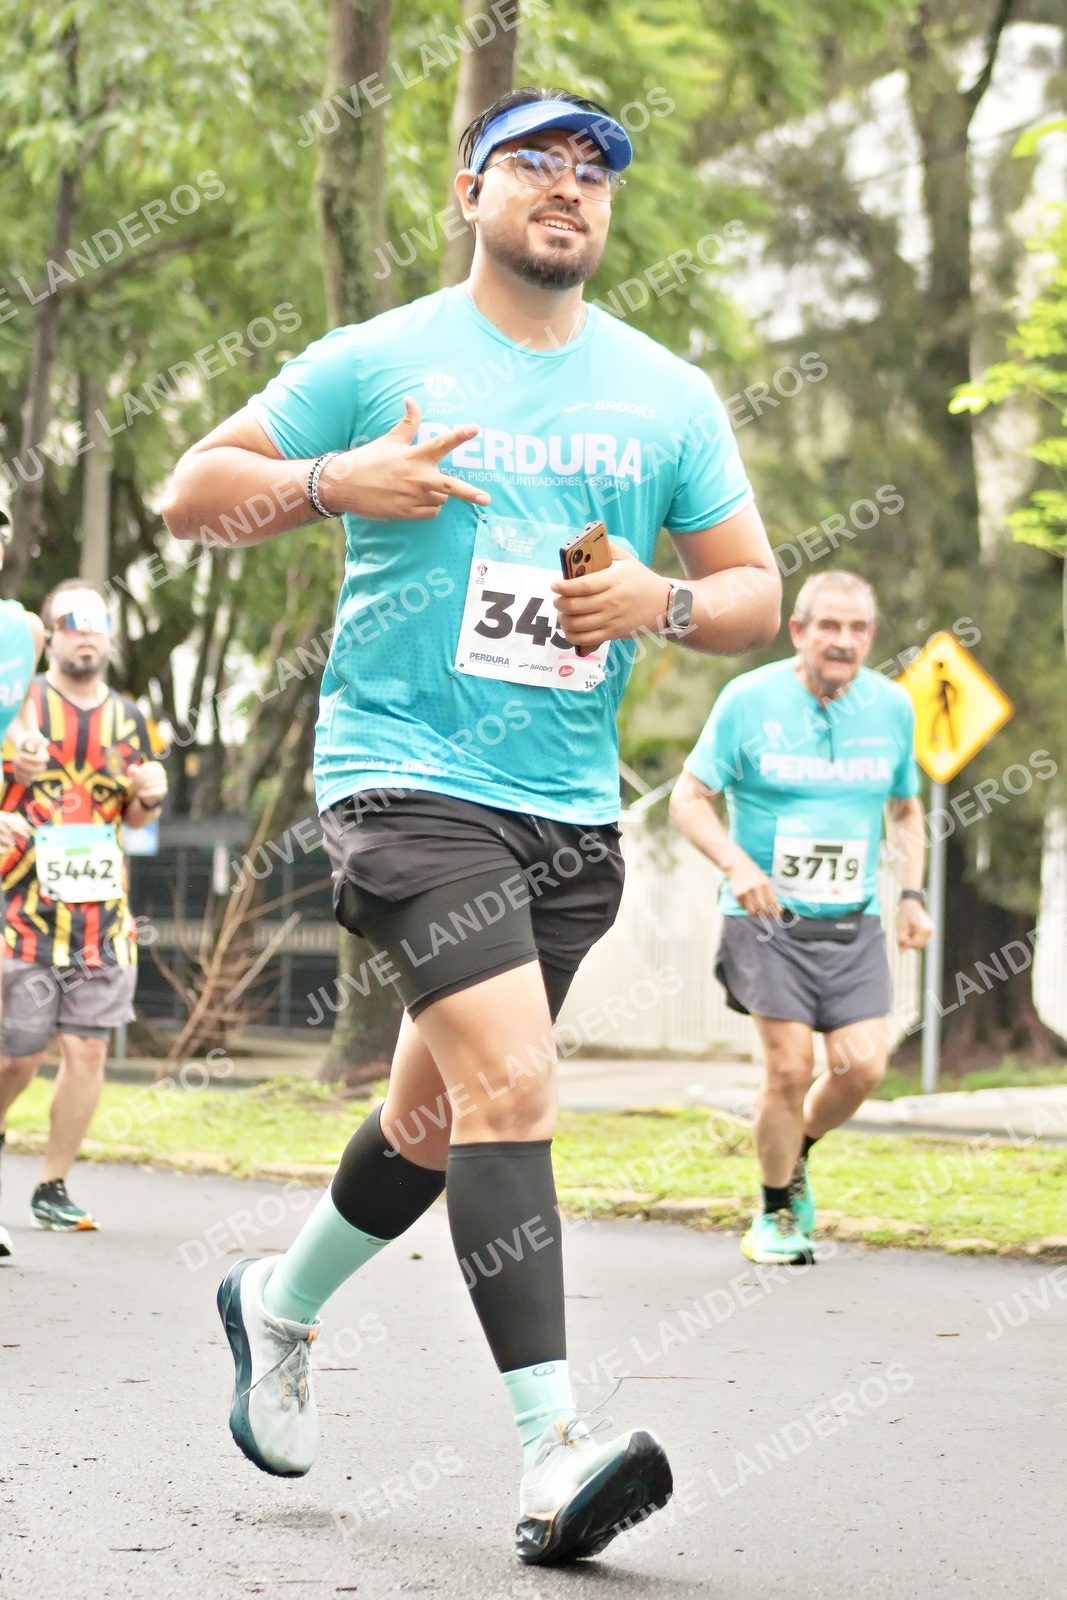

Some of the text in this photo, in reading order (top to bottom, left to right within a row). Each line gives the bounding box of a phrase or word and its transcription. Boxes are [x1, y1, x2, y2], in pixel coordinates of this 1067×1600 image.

[593, 400, 656, 420] BROOKS
[469, 652, 511, 666] PERDURA
[530, 664, 554, 672] BROOKS
[759, 752, 892, 782] PERDURA
[47, 859, 114, 881] 5442
[781, 854, 860, 881] 3719
